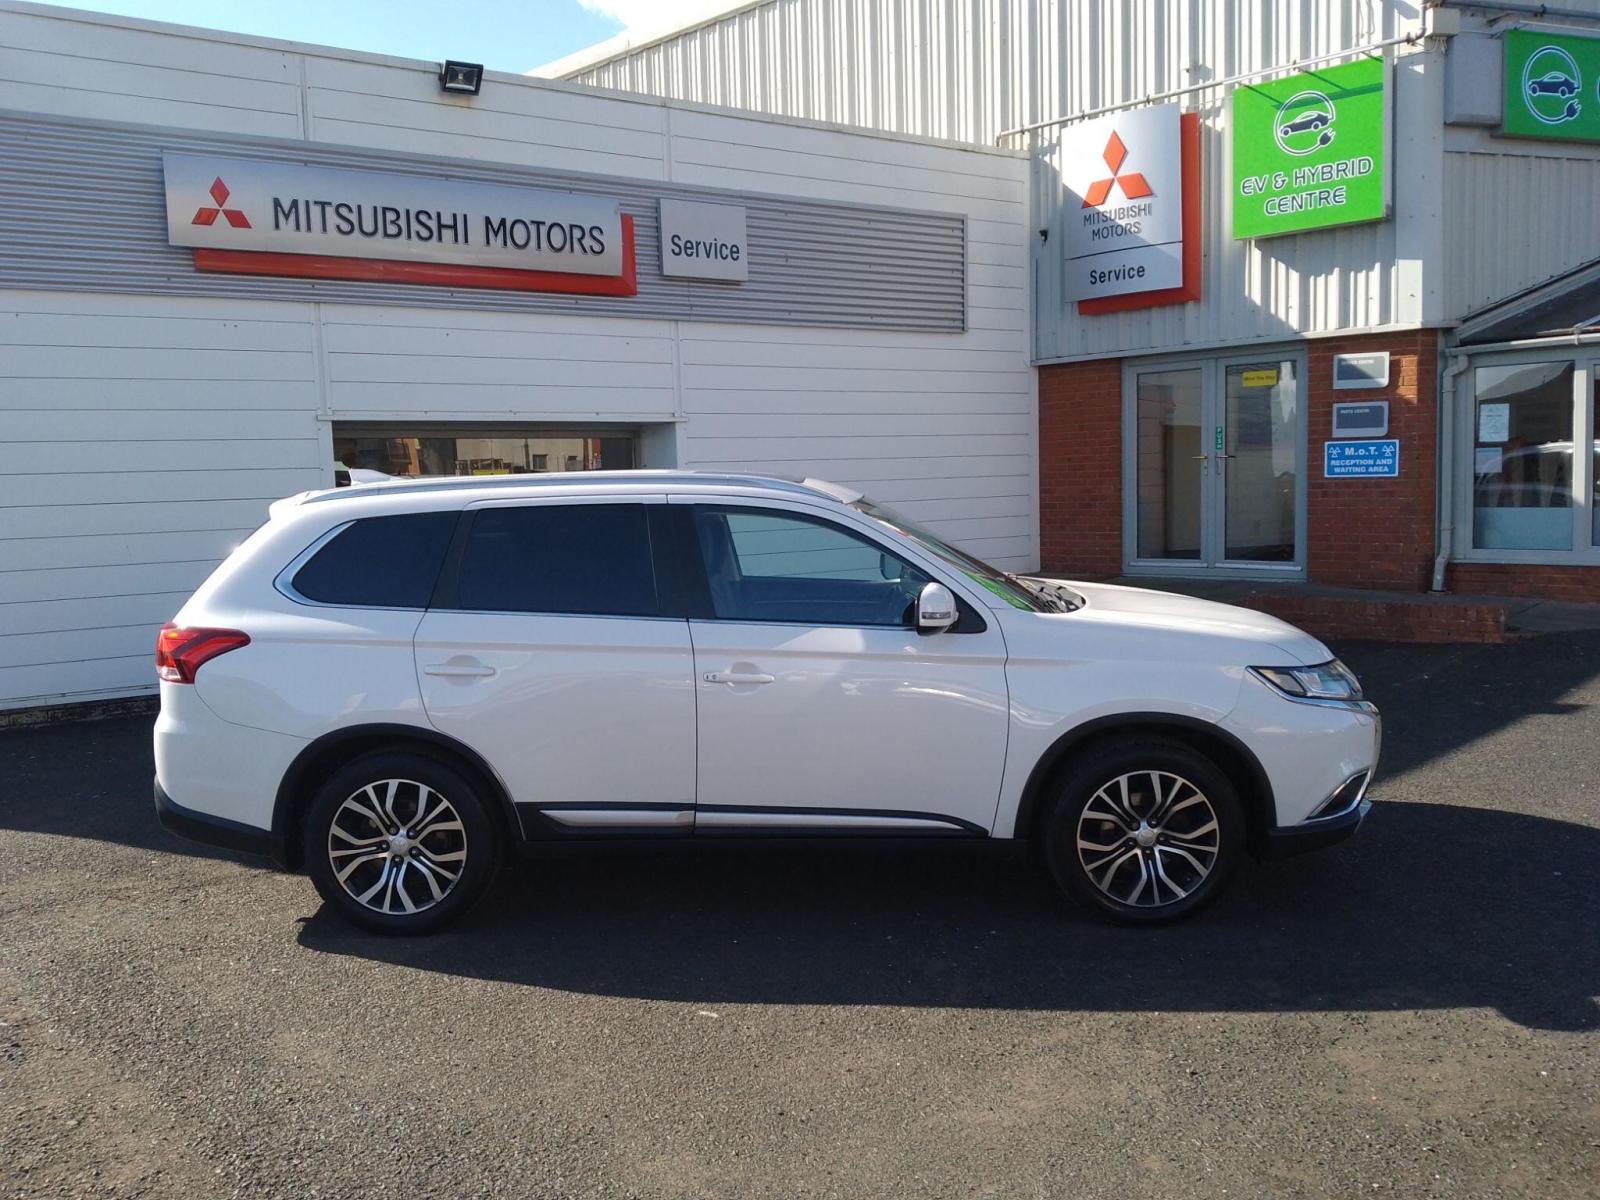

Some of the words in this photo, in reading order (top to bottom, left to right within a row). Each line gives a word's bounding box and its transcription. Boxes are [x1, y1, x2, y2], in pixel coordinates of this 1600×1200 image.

[1241, 175, 1267, 195] EV
[1273, 171, 1288, 190] &
[1293, 156, 1373, 188] HYBRID
[1264, 185, 1346, 216] CENTRE
[273, 197, 469, 245] MITSUBISHI
[484, 215, 606, 256] MOTORS
[1083, 202, 1153, 227] MITSUBISHI
[1091, 221, 1142, 241] MOTORS
[670, 234, 740, 262] Service
[1090, 264, 1146, 285] Service
[1368, 465, 1389, 473] AREA
